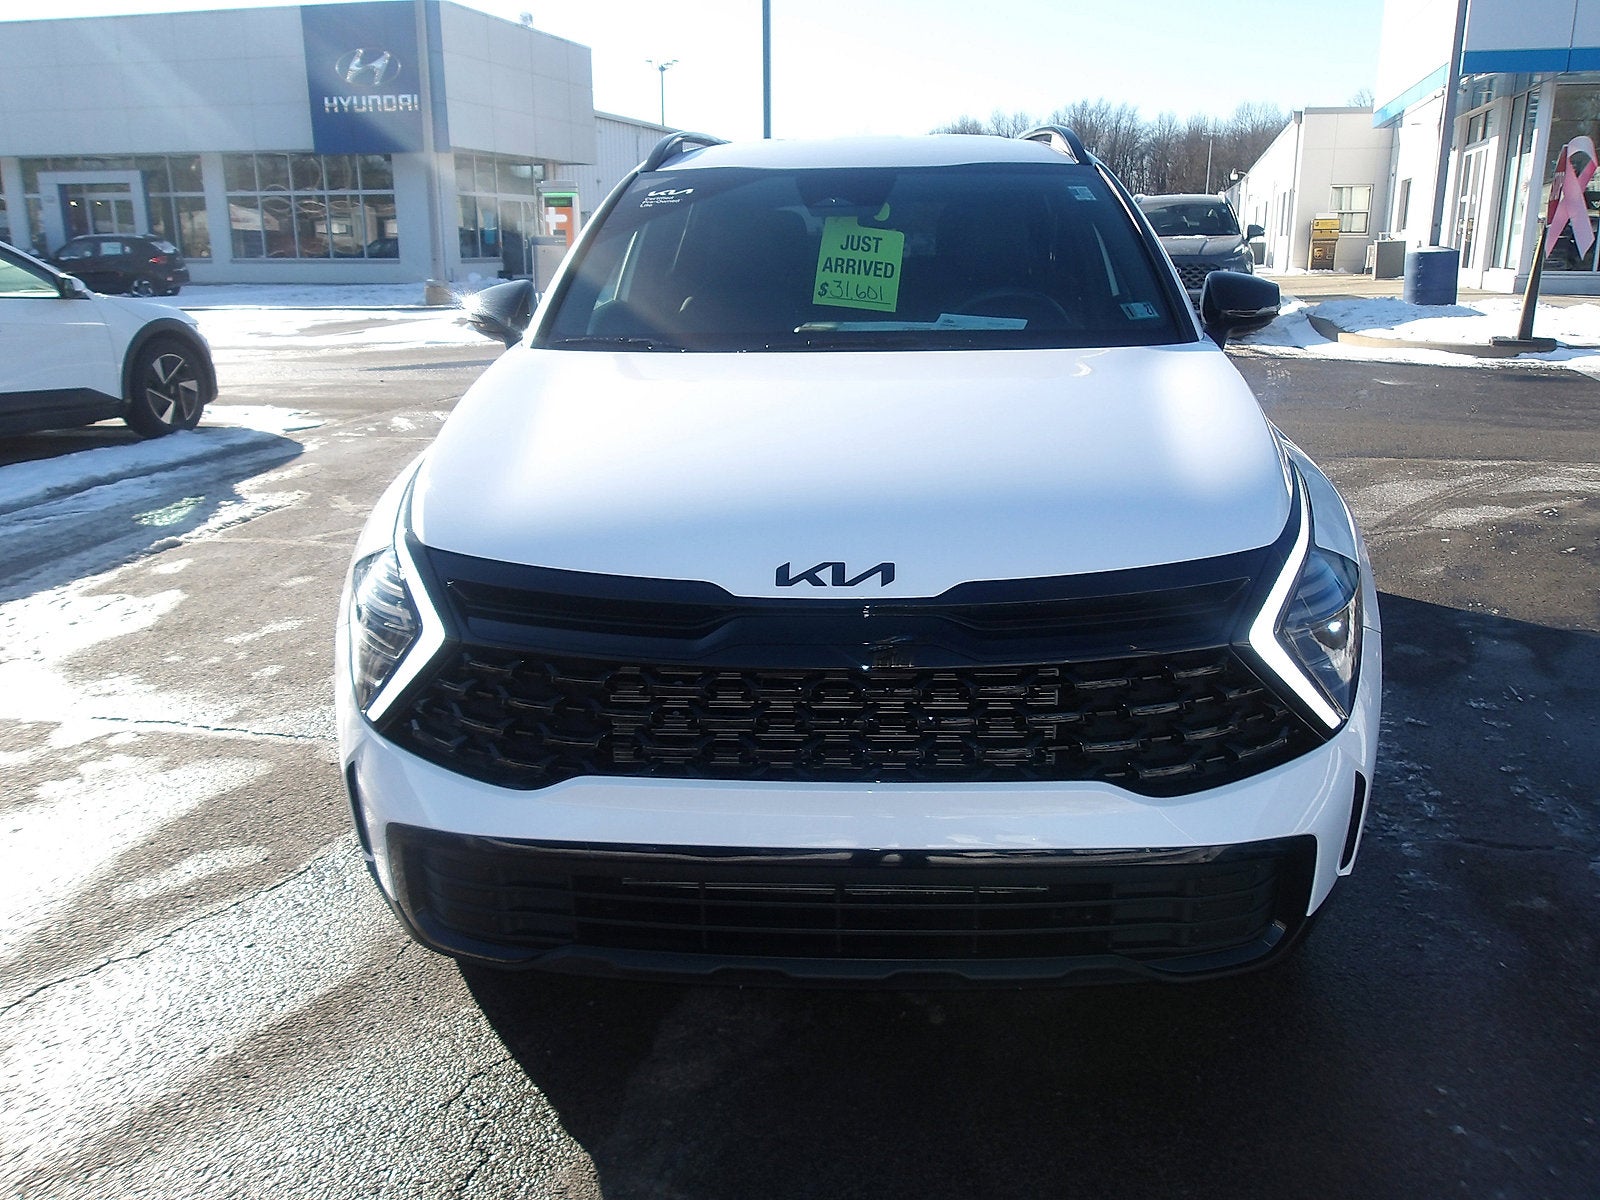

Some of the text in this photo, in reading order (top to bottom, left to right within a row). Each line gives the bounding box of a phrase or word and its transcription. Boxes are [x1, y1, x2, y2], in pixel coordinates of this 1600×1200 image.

[323, 93, 419, 113] HYUNDAI
[840, 234, 883, 254] JUST
[822, 256, 895, 279] ARRIVED
[775, 561, 896, 588] KIA
